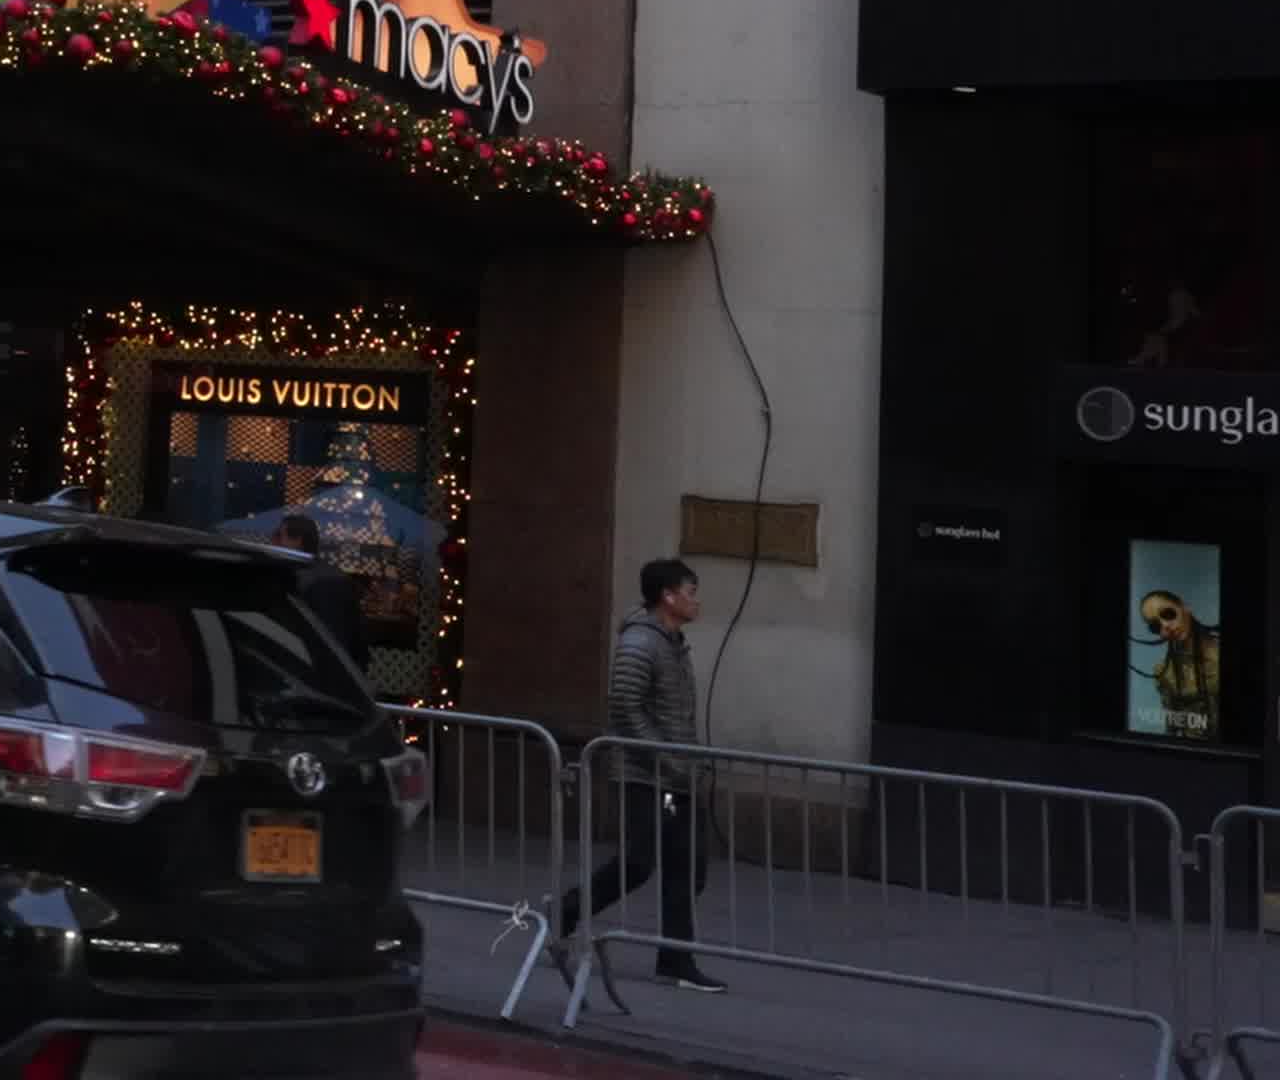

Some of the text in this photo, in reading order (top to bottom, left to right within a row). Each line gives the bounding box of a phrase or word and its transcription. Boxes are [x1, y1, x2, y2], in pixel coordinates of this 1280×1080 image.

[181, 376, 400, 411] LOUIS VUITTON
[1143, 396, 1279, 445] sungla
